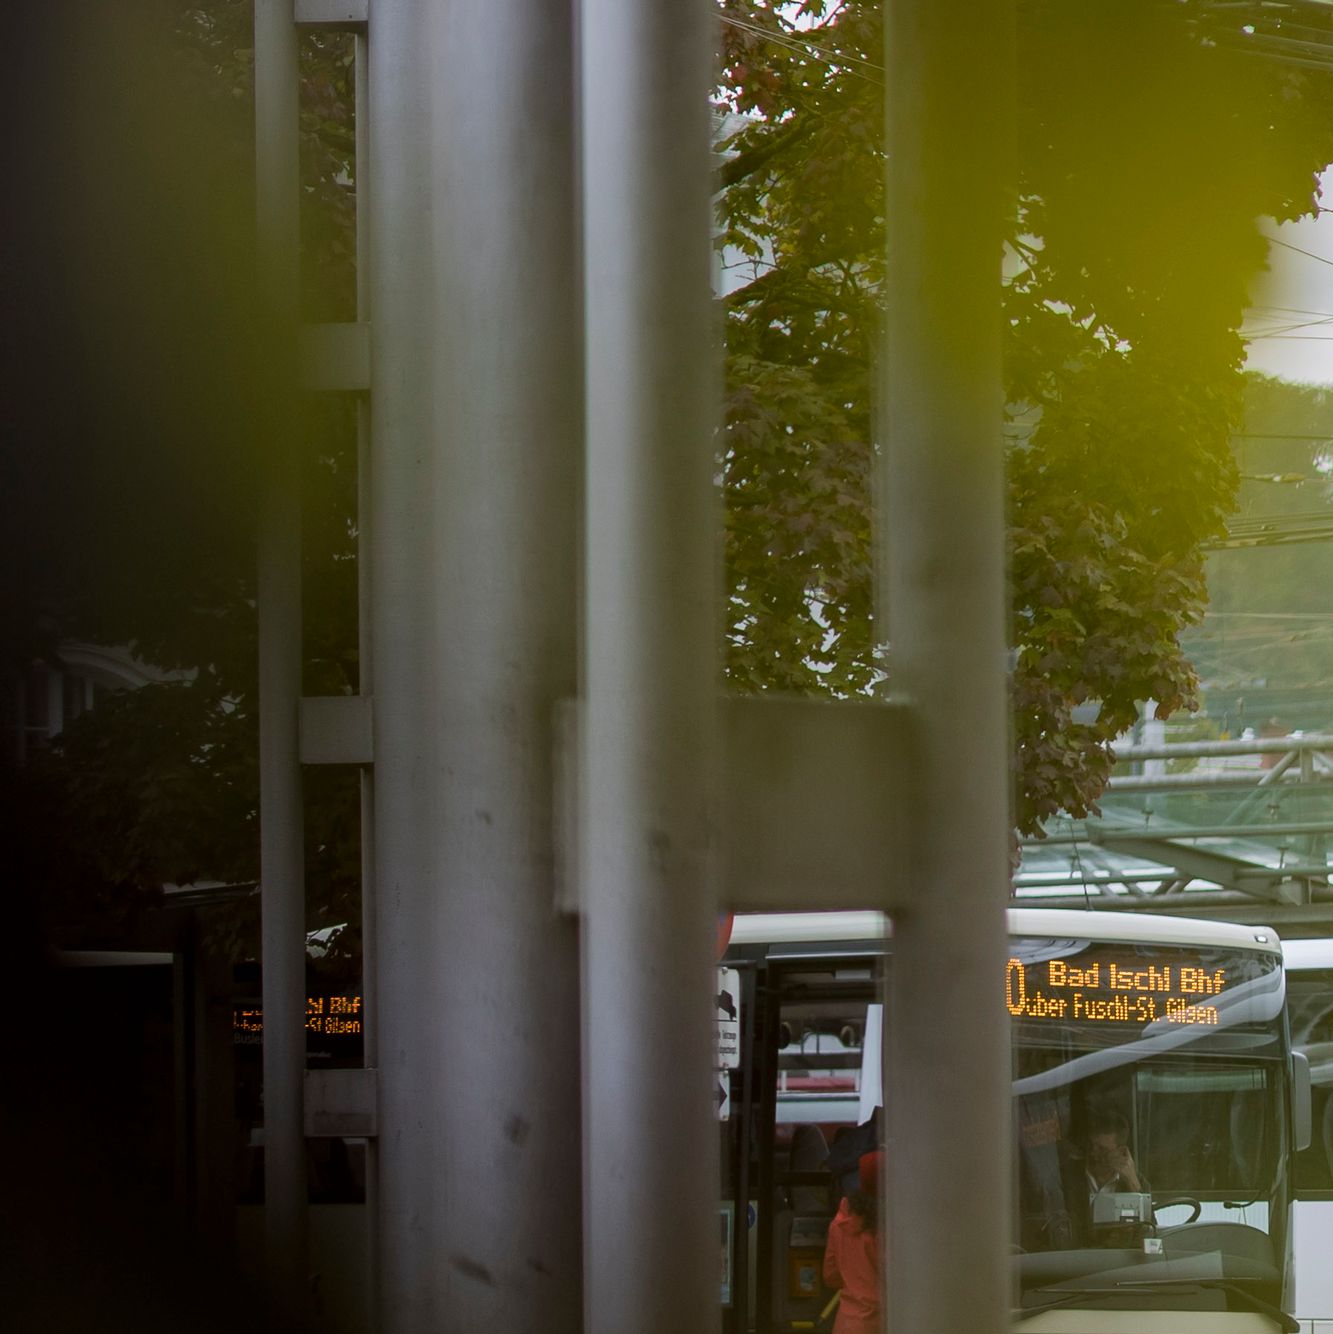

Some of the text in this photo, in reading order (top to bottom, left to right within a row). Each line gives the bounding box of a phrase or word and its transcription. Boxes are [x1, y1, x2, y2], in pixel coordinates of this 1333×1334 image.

[1049, 960, 1100, 988] Bad
[1109, 964, 1171, 992] Ischl
[1180, 967, 1226, 995] Bhf
